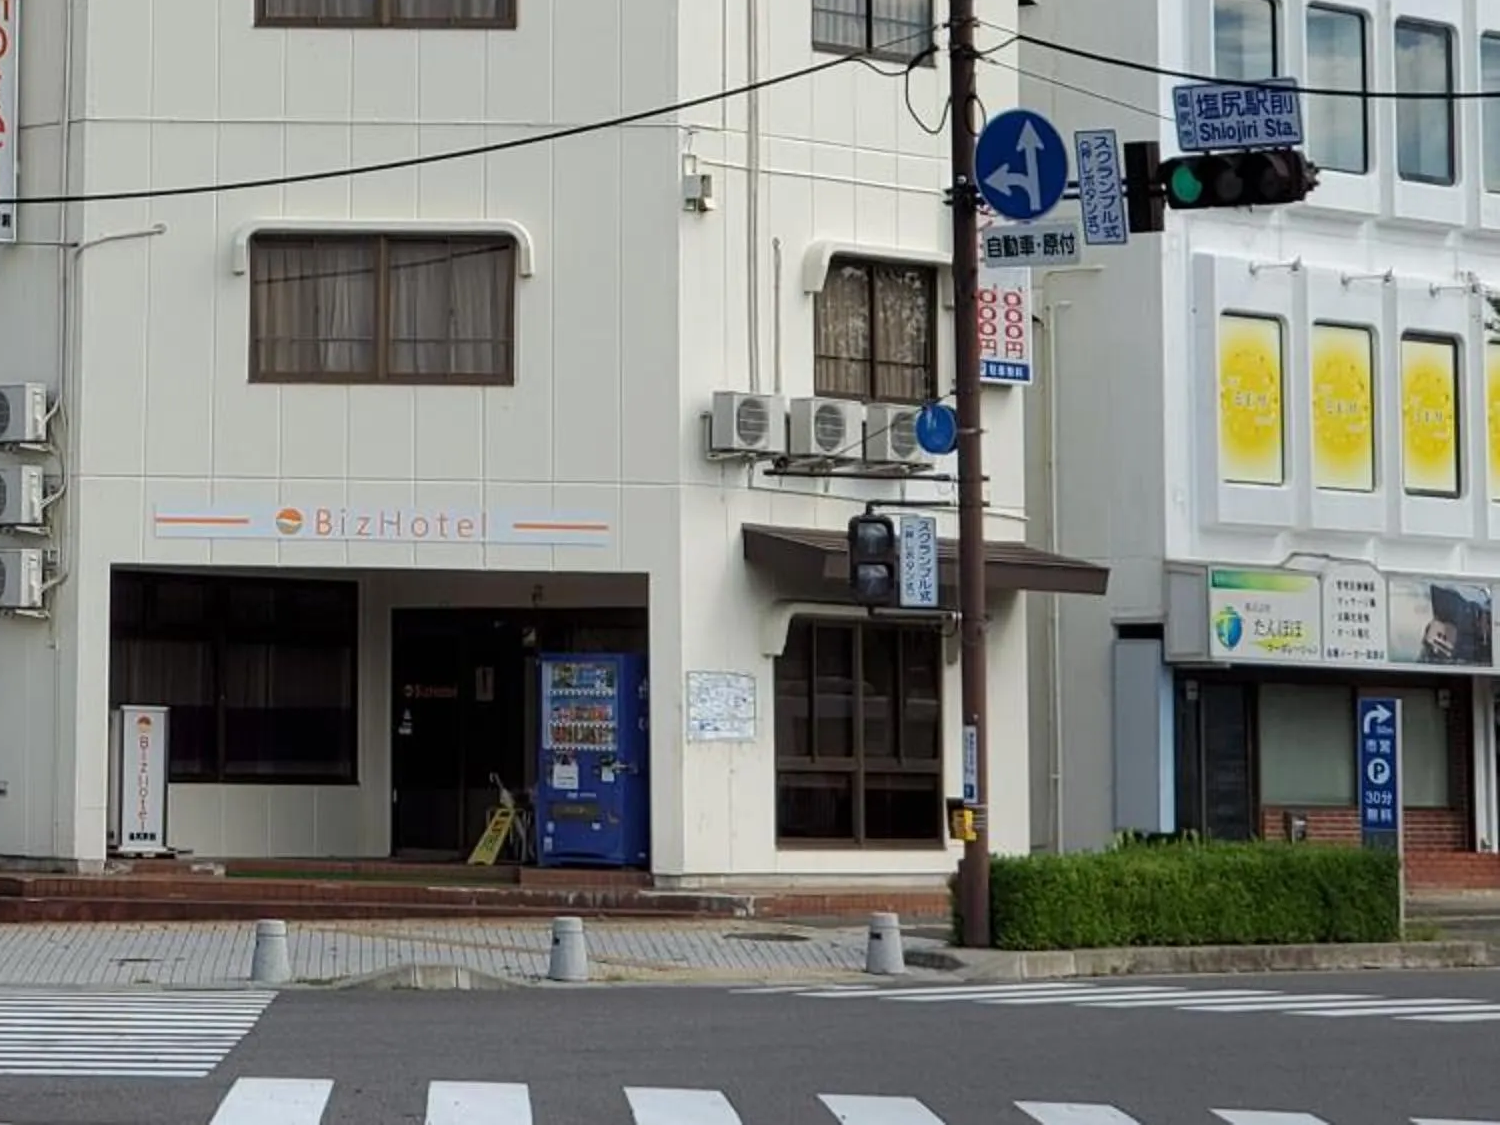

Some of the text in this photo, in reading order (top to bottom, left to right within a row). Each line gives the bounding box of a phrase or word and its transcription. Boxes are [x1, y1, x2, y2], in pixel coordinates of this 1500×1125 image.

[1196, 88, 1292, 120] 塩尻駅前
[1199, 118, 1299, 143] Shiojiri Sta.
[1094, 136, 1121, 239] スクランブル式
[986, 232, 1076, 258] 自動車・原付
[315, 507, 488, 540] BizHotel
[919, 520, 933, 602] スクランブル式
[1365, 791, 1392, 805] 30分
